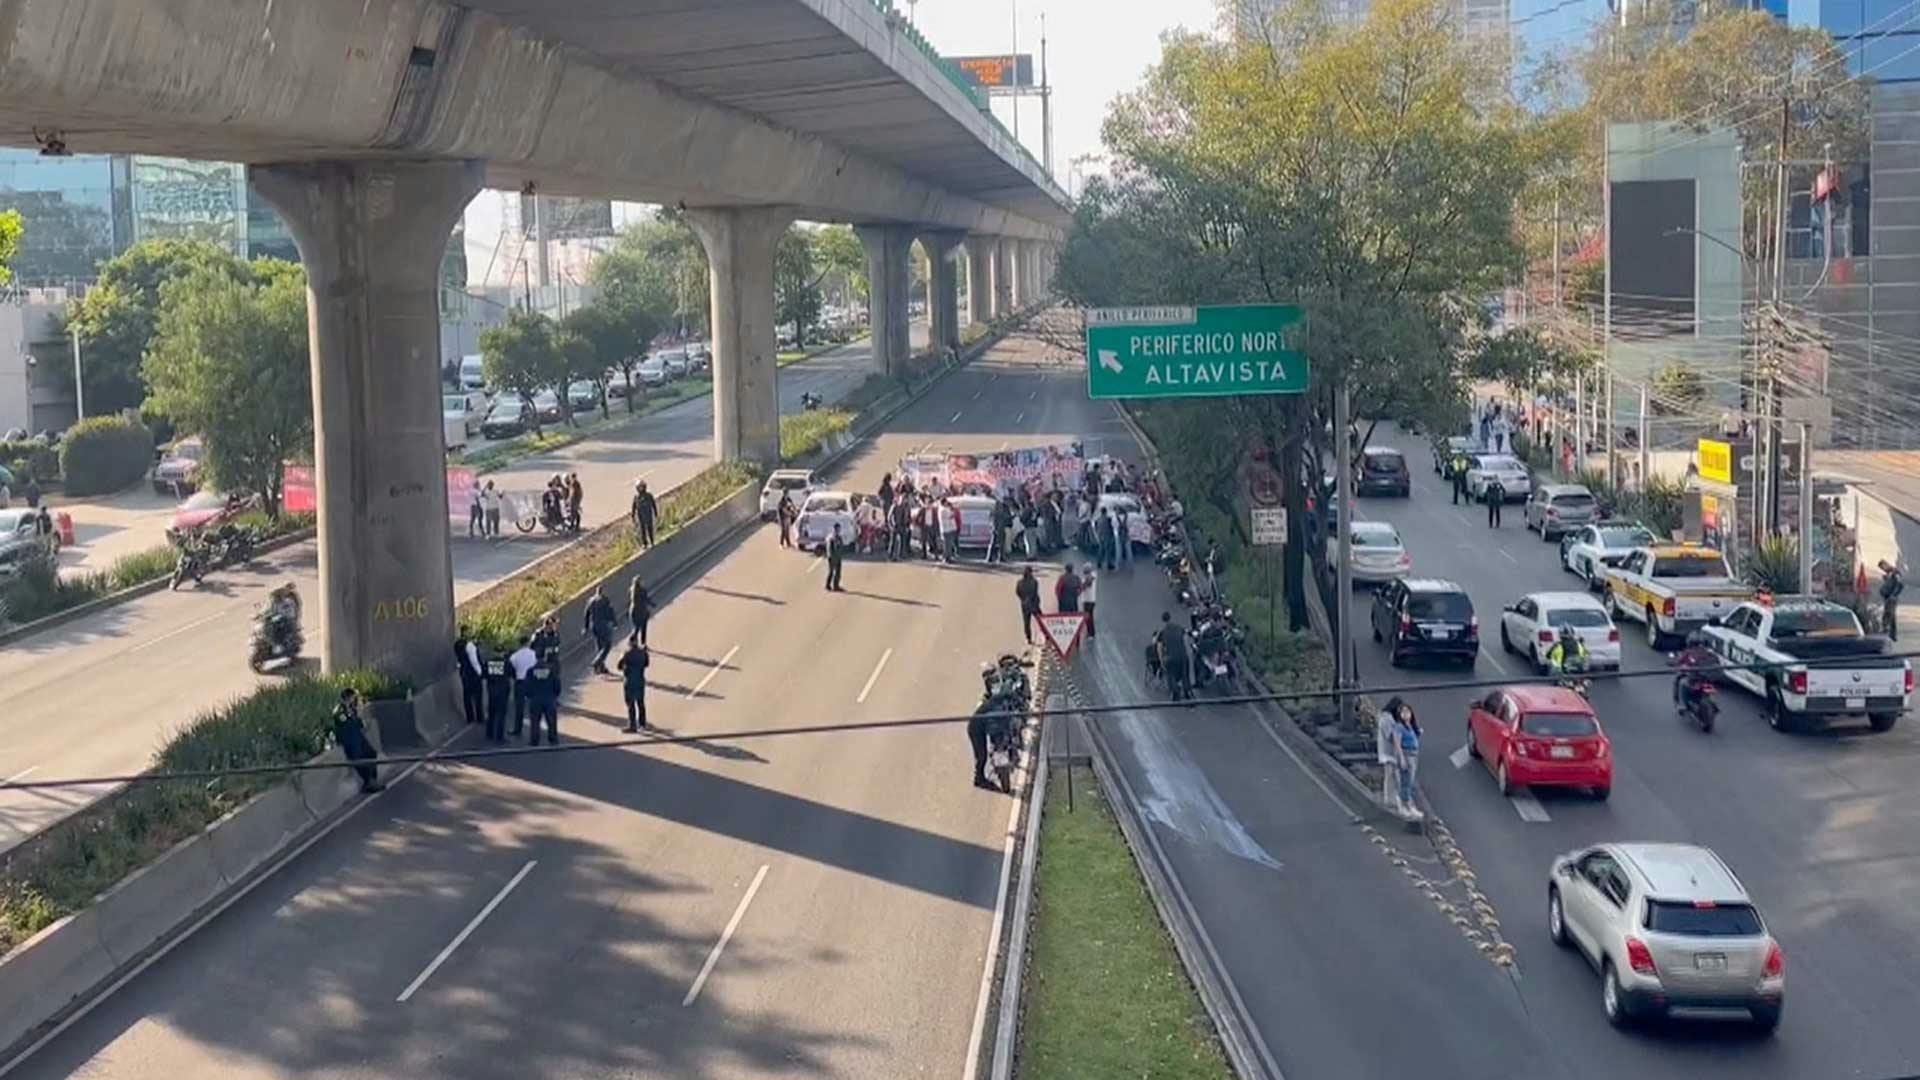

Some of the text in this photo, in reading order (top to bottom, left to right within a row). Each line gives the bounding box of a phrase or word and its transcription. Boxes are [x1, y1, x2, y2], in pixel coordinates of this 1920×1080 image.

[1131, 331, 1287, 356] PERIFERICO NORT
[1145, 361, 1287, 384] ALTAVISTA
[395, 597, 429, 619] 106
